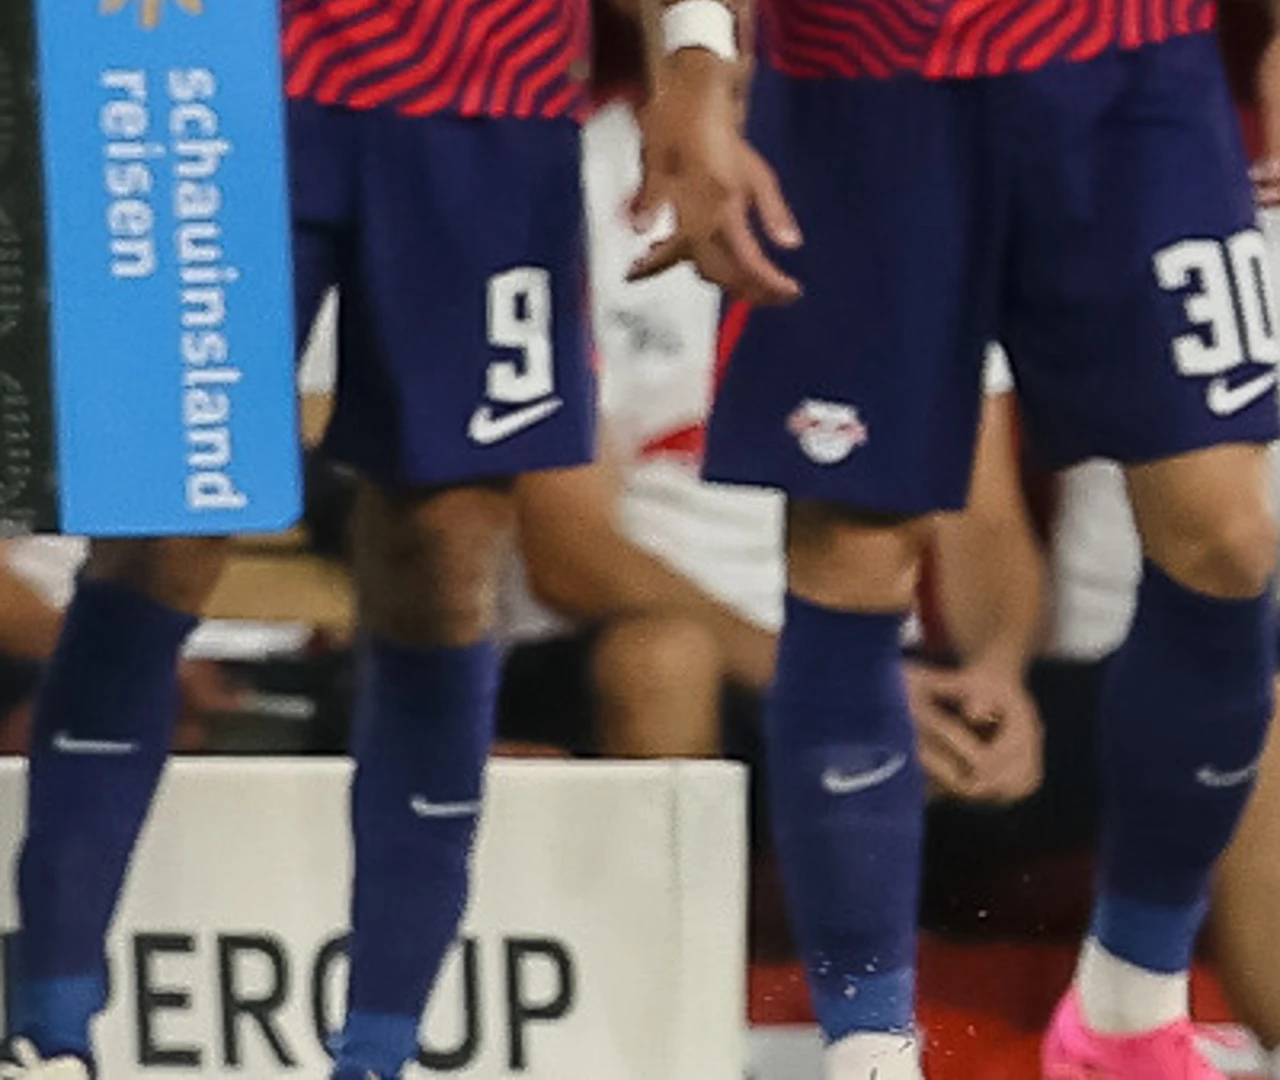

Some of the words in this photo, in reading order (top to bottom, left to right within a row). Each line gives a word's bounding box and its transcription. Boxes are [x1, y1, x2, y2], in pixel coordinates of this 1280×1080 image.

[100, 68, 166, 278] reisen
[168, 67, 248, 511] schauinsland
[486, 266, 555, 404] 9
[1153, 231, 1280, 377] 30
